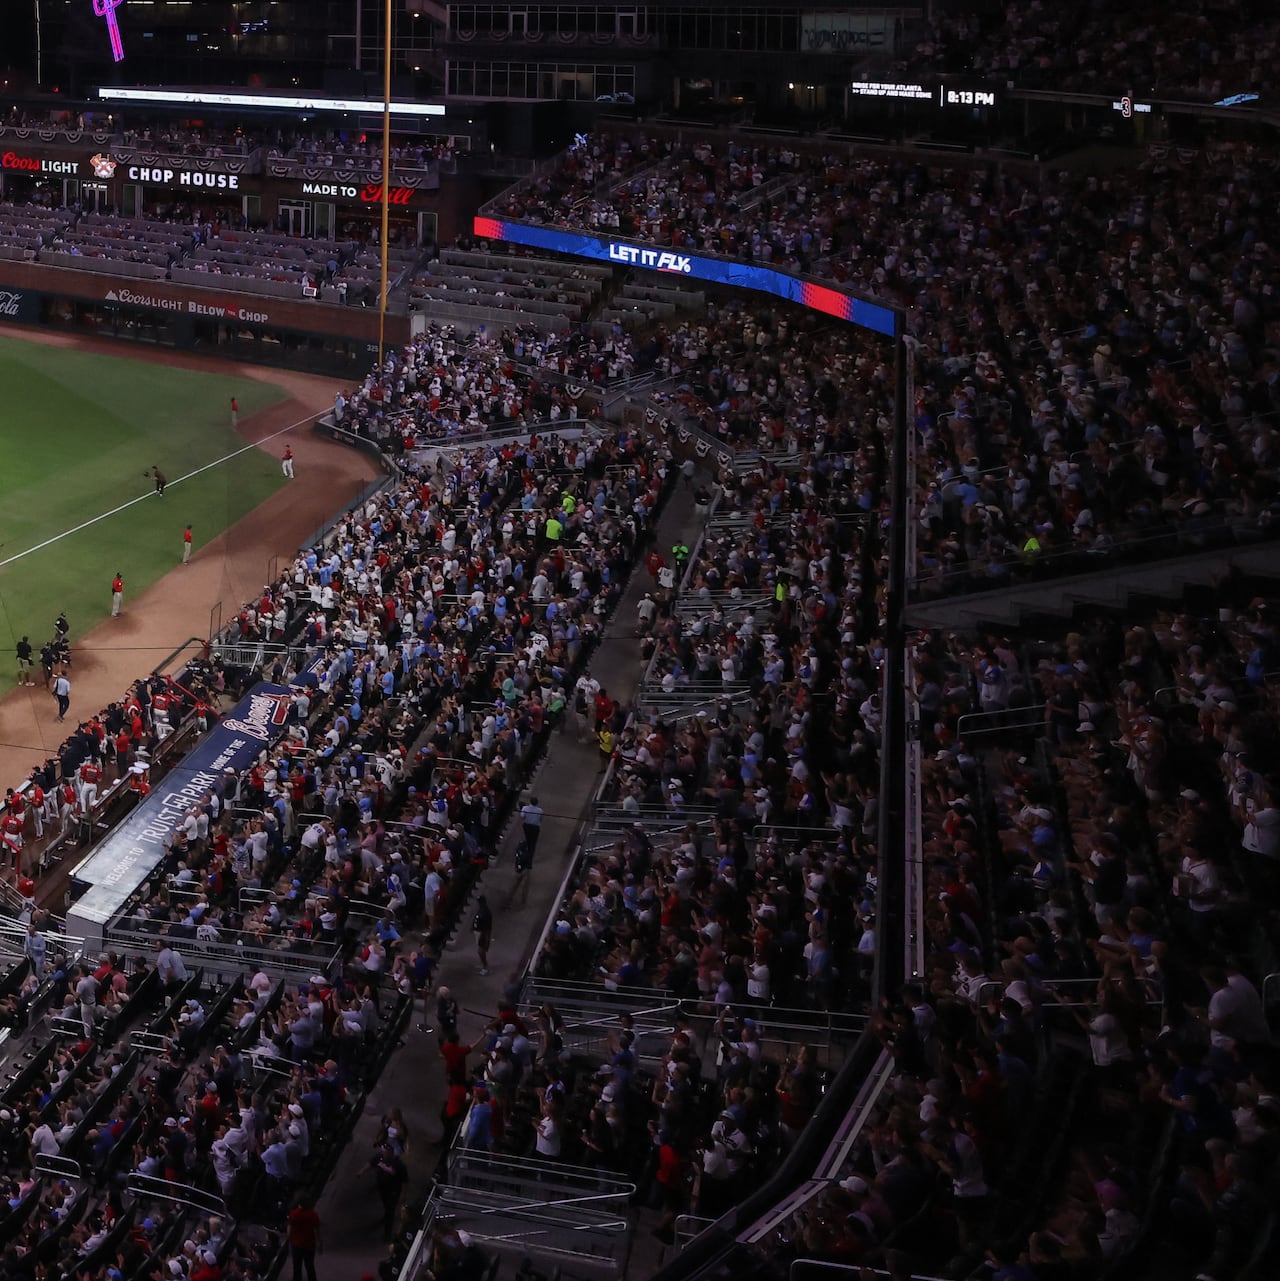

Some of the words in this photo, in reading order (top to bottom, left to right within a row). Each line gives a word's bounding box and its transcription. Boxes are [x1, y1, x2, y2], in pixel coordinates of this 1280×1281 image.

[896, 84, 922, 92] ATLANTA
[899, 90, 915, 98] MAKE
[915, 91, 932, 99] SOME
[947, 90, 974, 104] 8:13
[975, 92, 995, 105] PM
[1121, 97, 1131, 118] 3
[2, 151, 40, 170] Coors
[41, 160, 79, 174] LIGHT
[129, 166, 173, 184] CHOP
[180, 172, 239, 189] HOUSE
[302, 183, 337, 196] MADE
[341, 186, 357, 197] TO
[610, 244, 639, 262] LET
[642, 250, 658, 265] IT
[119, 289, 151, 305] Coors
[152, 299, 183, 310] LIGHT
[188, 301, 225, 317] BELOW
[238, 309, 268, 323] CHOP
[223, 694, 276, 741] Braves
[190, 771, 218, 803] PARK
[138, 807, 178, 845] TRUIST
[135, 847, 145, 858] TO
[102, 854, 138, 887] WELCOME
